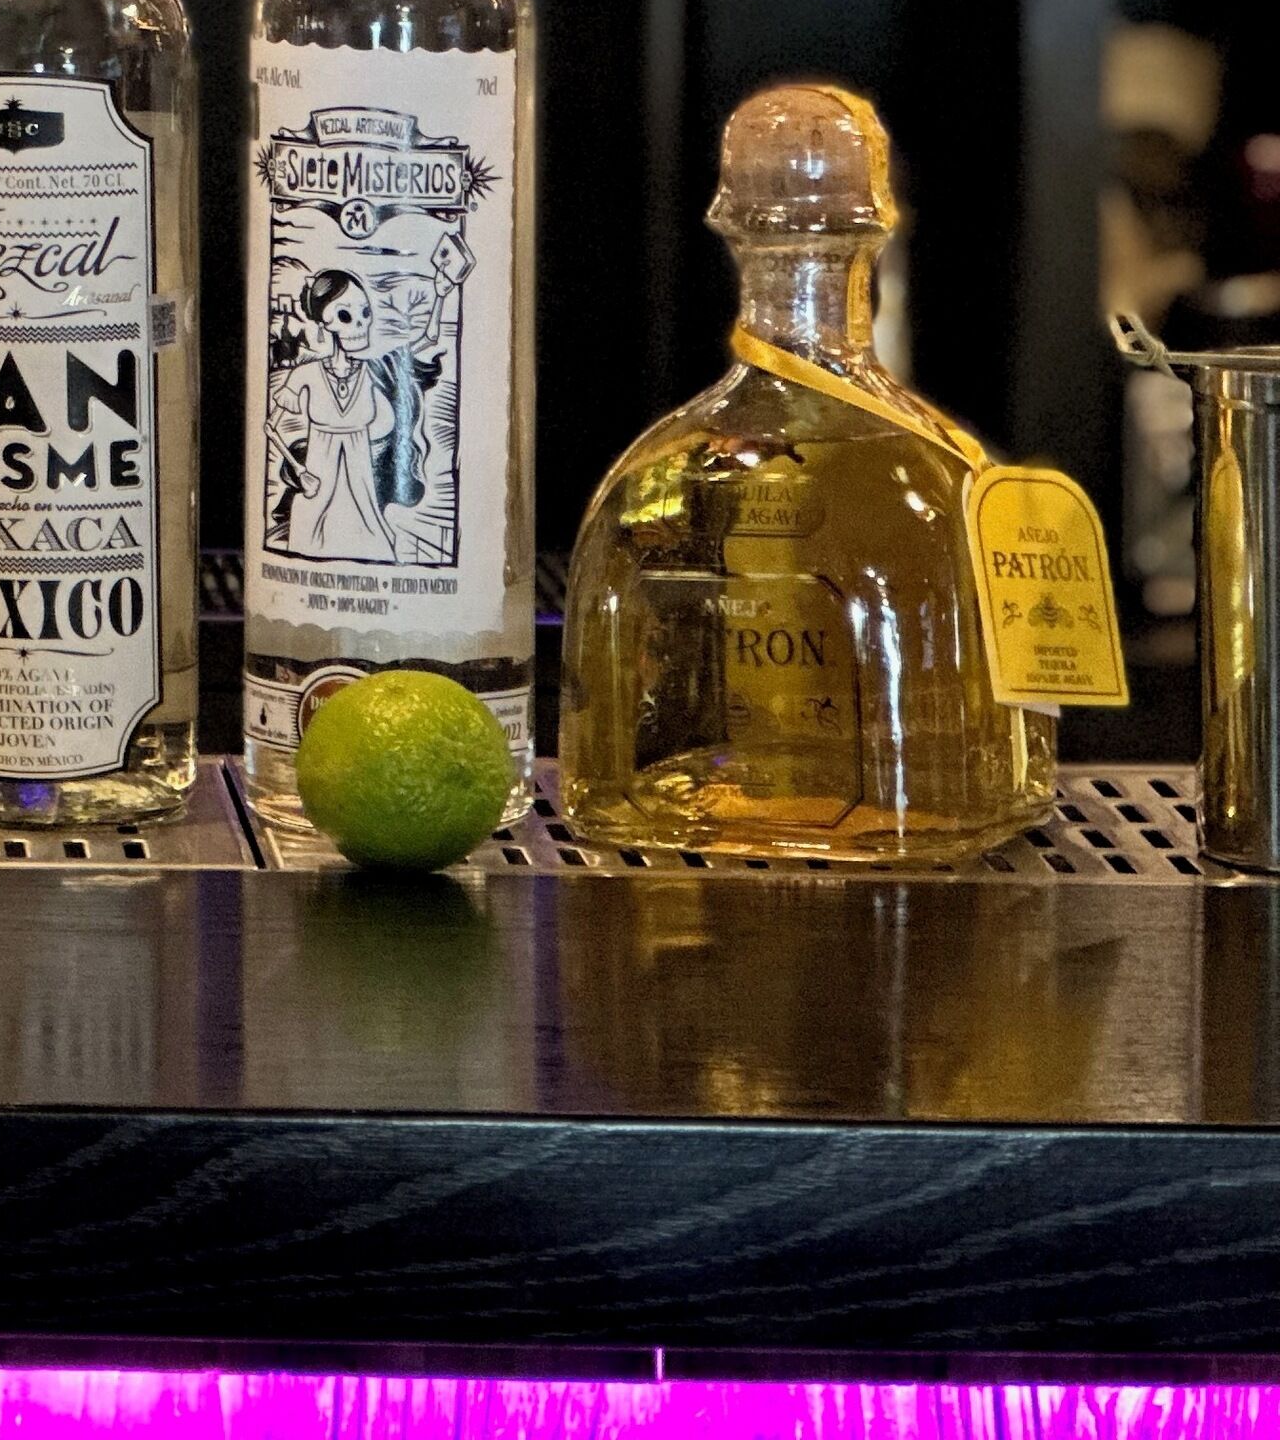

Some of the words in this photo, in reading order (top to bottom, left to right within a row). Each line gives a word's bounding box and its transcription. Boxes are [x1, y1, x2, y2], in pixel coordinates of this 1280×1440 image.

[82, 173, 101, 189] 70
[89, 698, 115, 714] OF
[48, 715, 115, 731] ORIGIN
